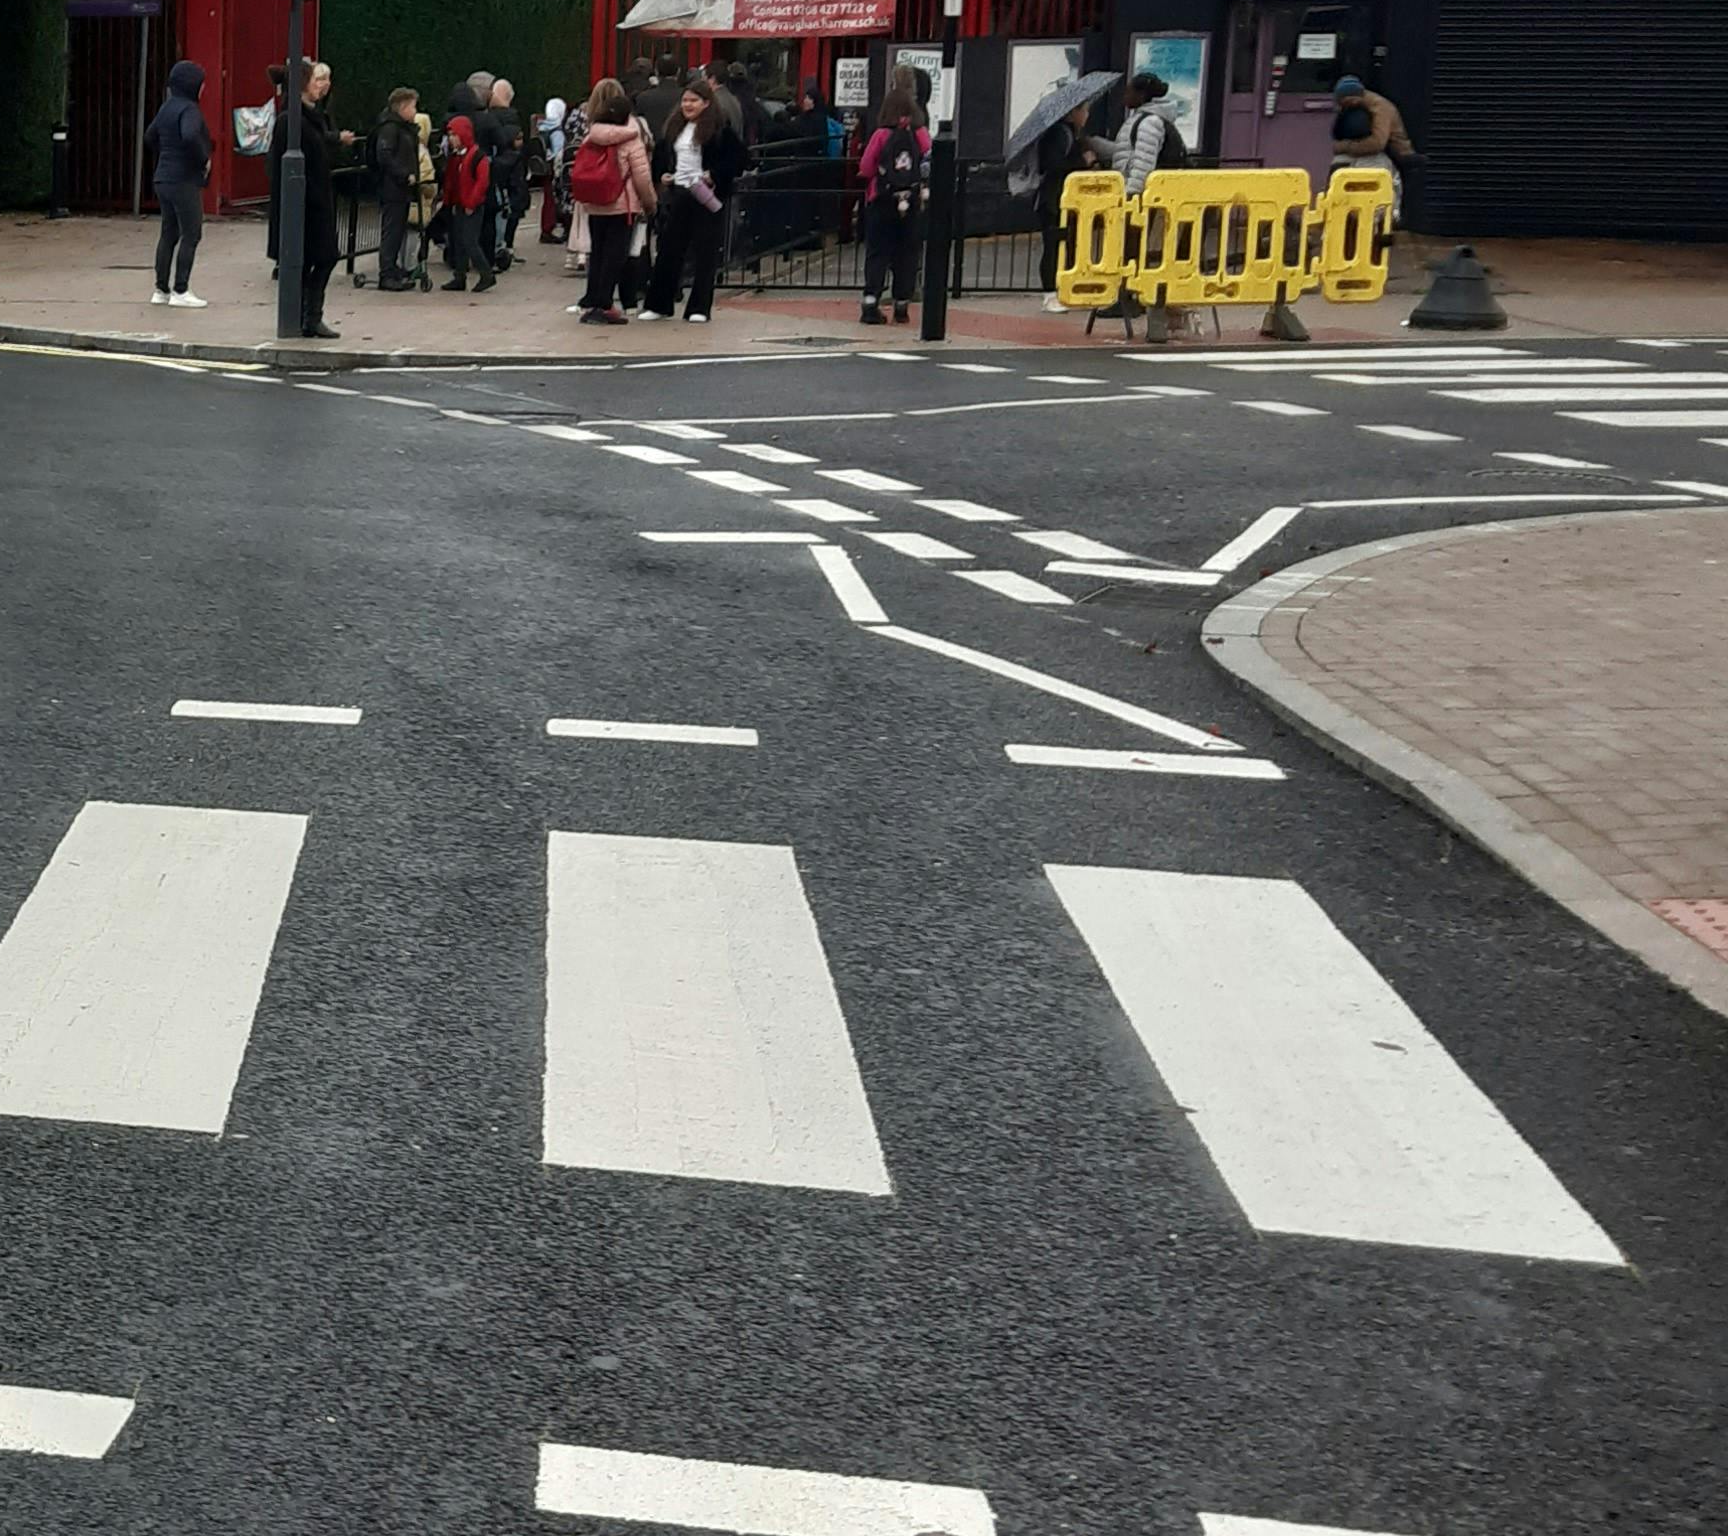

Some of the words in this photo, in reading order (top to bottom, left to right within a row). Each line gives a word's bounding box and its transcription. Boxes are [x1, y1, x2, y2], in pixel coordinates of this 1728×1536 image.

[752, 5, 792, 17] Contact
[866, 2, 878, 13] or
[899, 51, 940, 65] Summ
